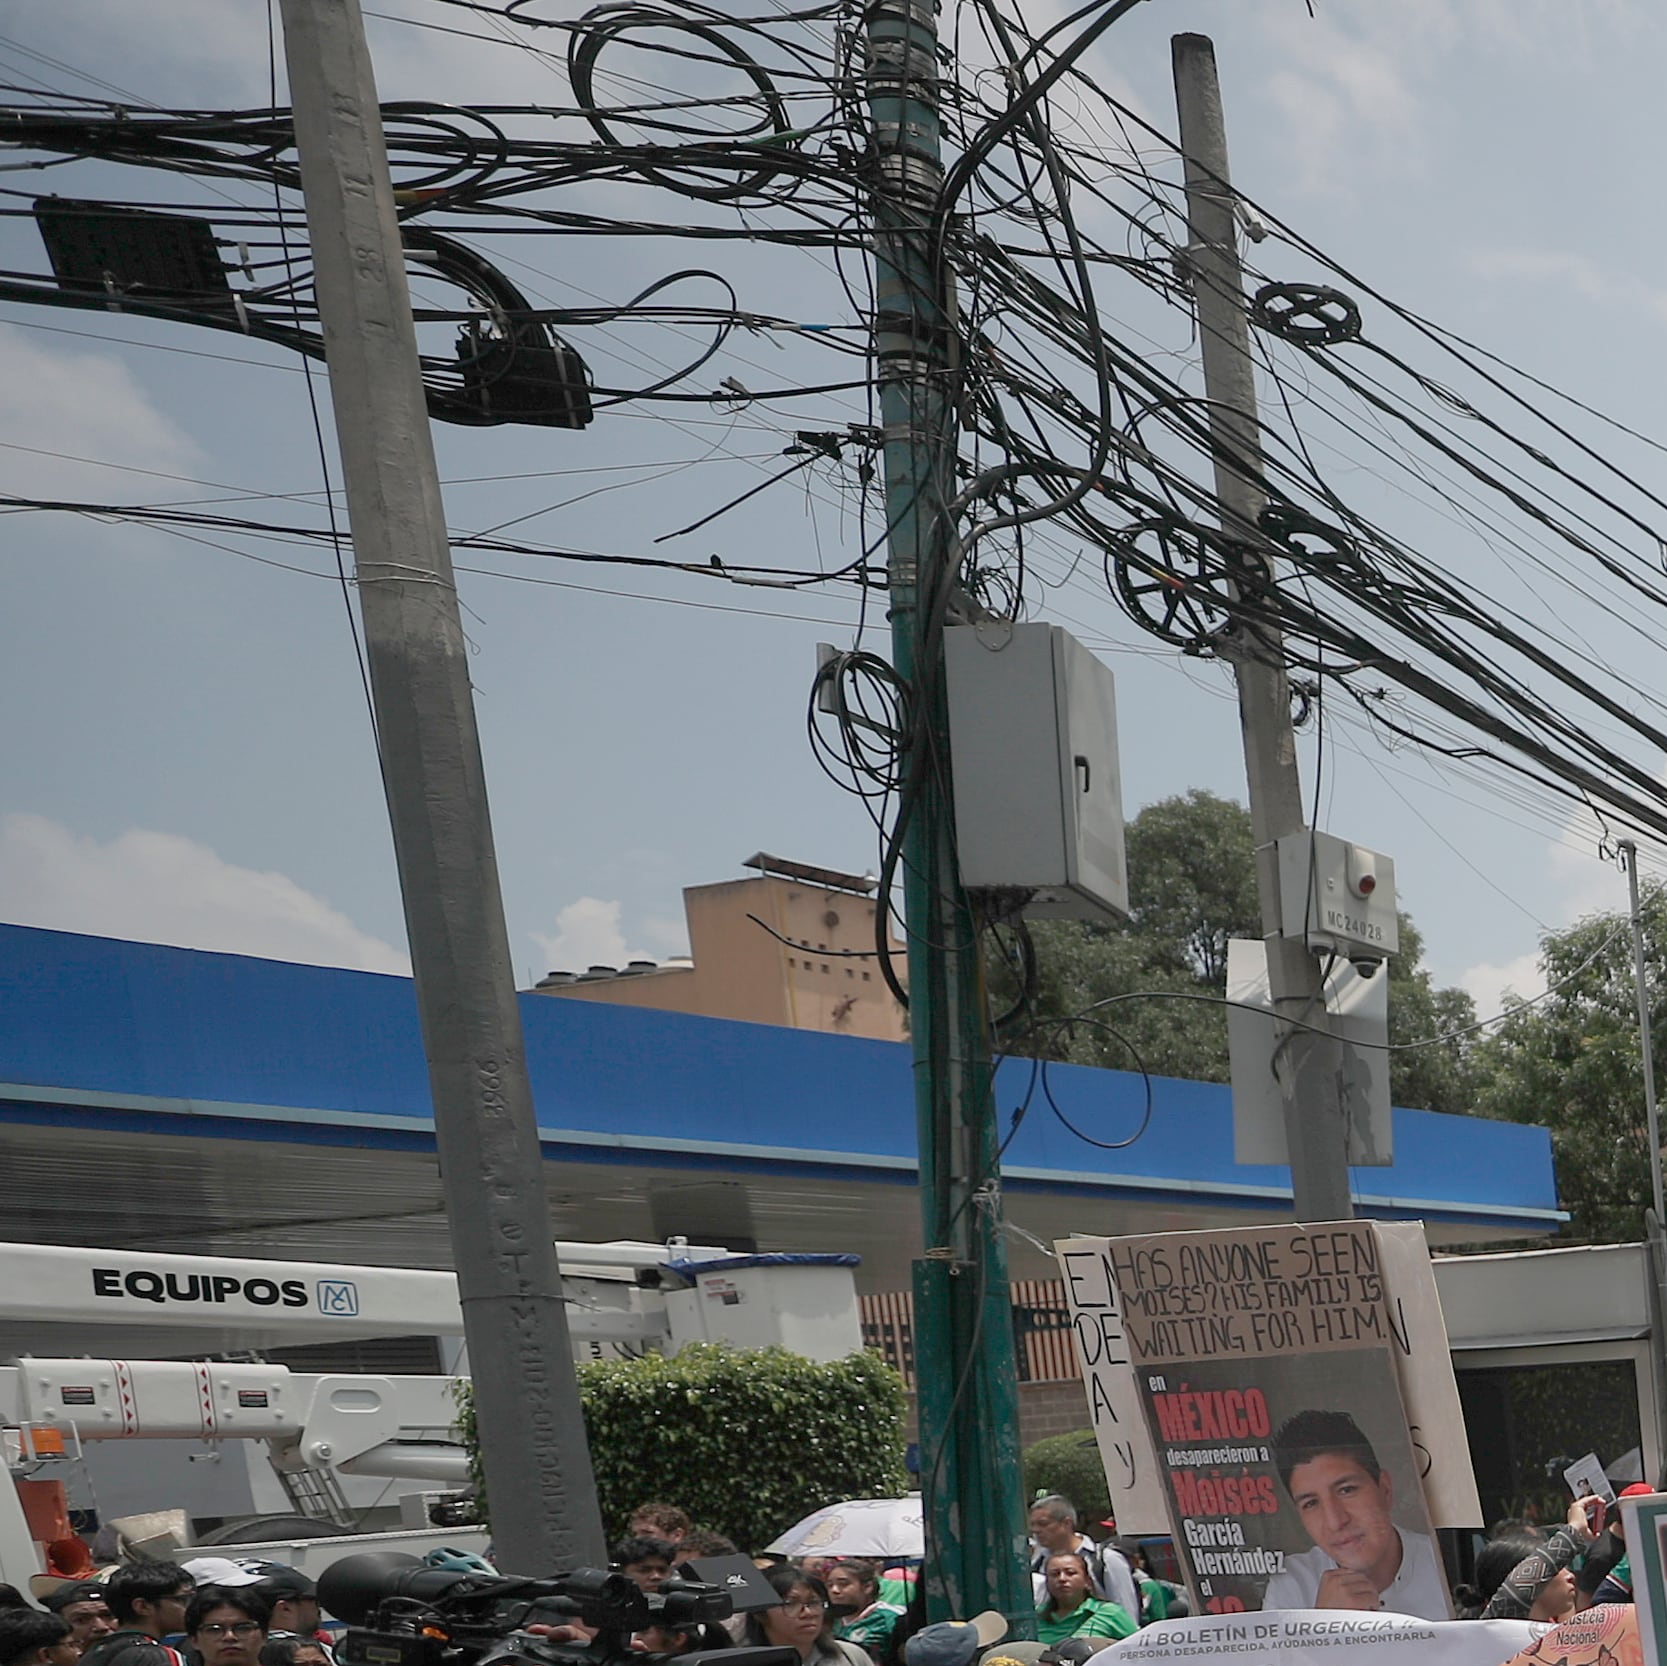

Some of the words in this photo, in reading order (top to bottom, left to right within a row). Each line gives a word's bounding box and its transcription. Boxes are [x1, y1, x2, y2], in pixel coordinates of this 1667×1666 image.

[1110, 1247, 1173, 1290] HAS
[1179, 1240, 1282, 1286] ANYONE
[1290, 1230, 1379, 1280] SEEN
[92, 1268, 308, 1307] EQUIPOS
[1265, 1277, 1351, 1310] FAMILY
[1359, 1273, 1383, 1303] IS
[1126, 1314, 1245, 1358] WAITING
[1252, 1312, 1304, 1352] FOR
[1149, 1374, 1166, 1392] en
[1153, 1383, 1272, 1442] MÉXICO
[1166, 1447, 1258, 1467] desaparecieron
[1259, 1446, 1269, 1462] a
[1171, 1467, 1279, 1517] Moisés
[1182, 1517, 1244, 1548] García
[1190, 1548, 1287, 1575] Hernández
[1200, 1579, 1212, 1597] el
[1120, 1648, 1171, 1660] PERSONA
[1334, 1637, 1343, 1646] A
[1345, 1630, 1436, 1645] ENCONTRARLA
[1156, 1623, 1248, 1646] BOLETÍN
[1254, 1623, 1280, 1639] DE
[1284, 1619, 1394, 1637] URGENCIA
[1556, 1630, 1600, 1646] Nacional
